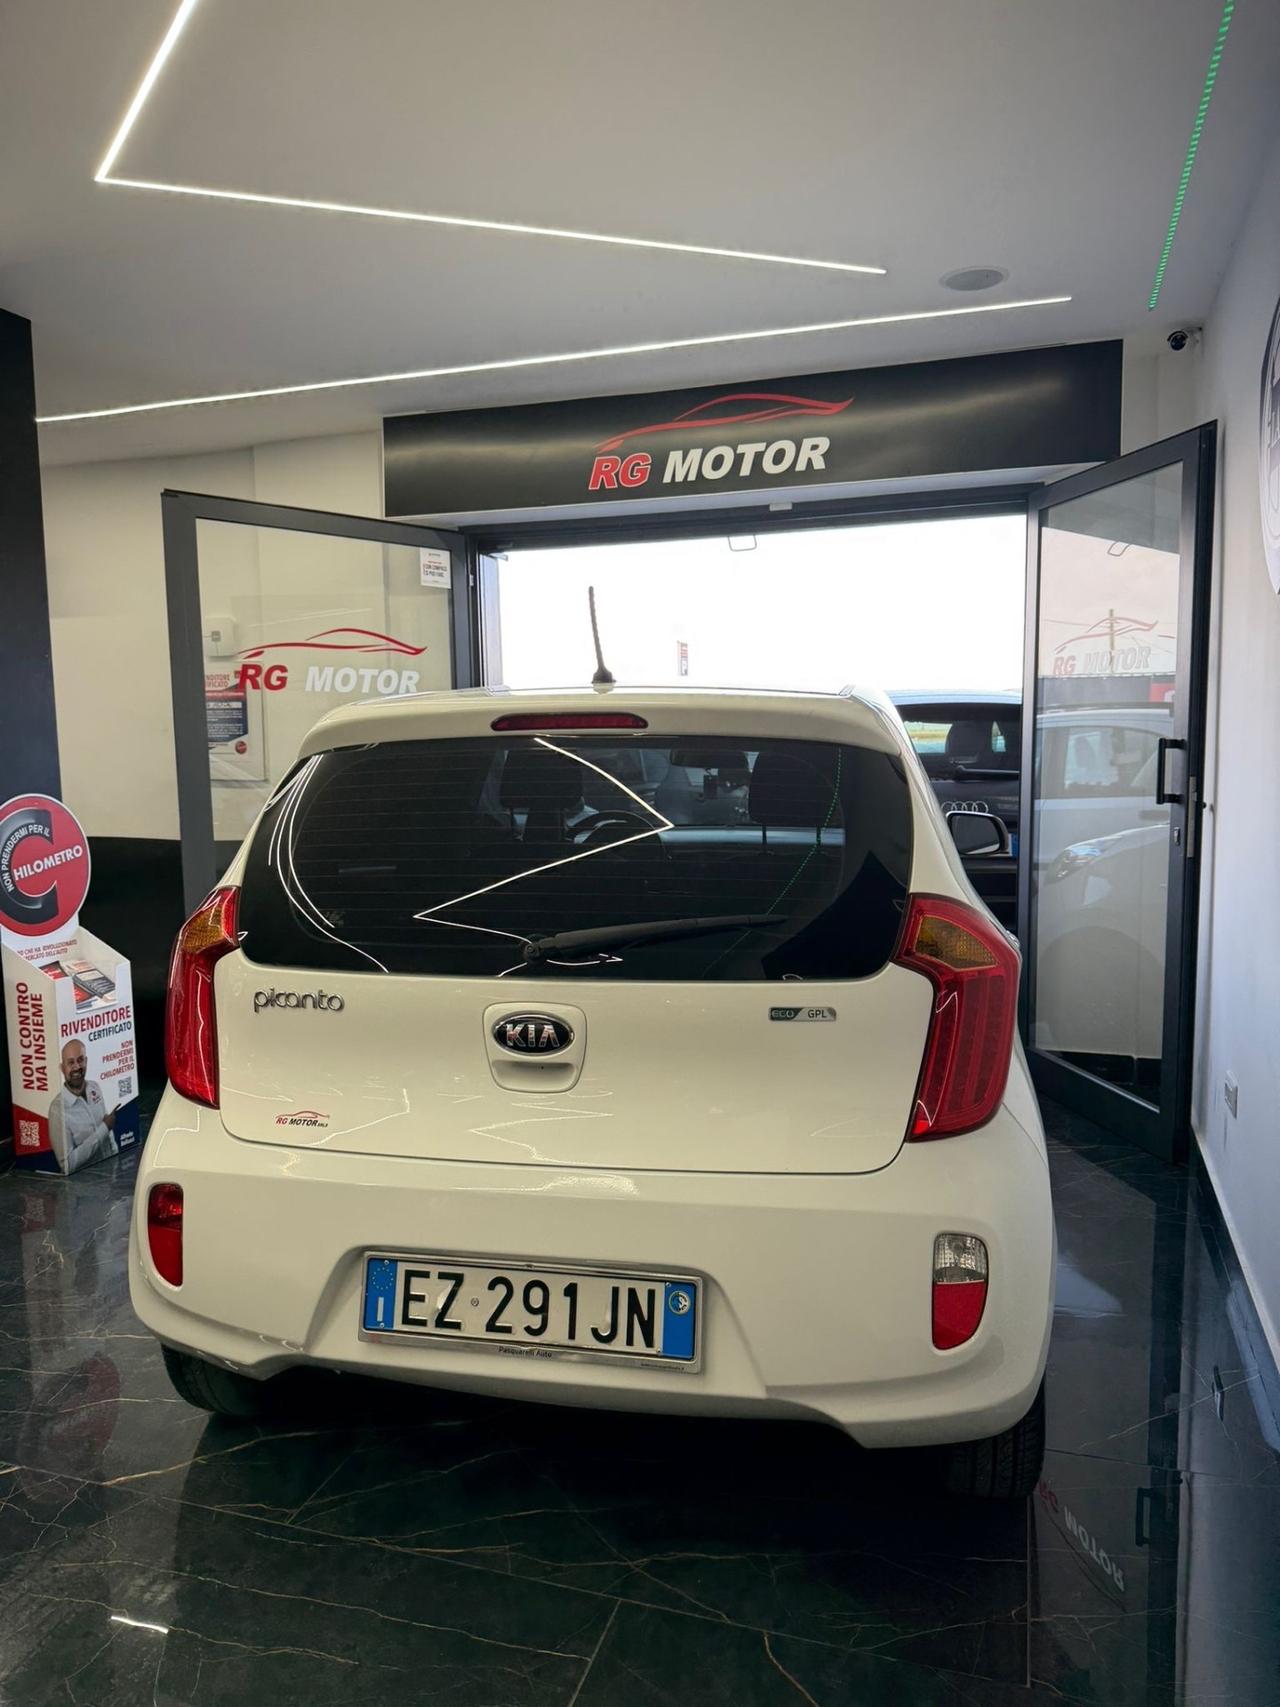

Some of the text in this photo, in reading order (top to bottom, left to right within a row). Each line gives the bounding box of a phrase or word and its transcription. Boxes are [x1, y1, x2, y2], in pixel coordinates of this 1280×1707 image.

[588, 436, 831, 490] RG MOTOR
[1053, 646, 1151, 676] RG MOTOR
[238, 664, 420, 693] RG MOTOR
[28, 824, 44, 834] PER
[1, 826, 29, 871] PRENDERMI
[2, 872, 15, 892] NON
[254, 987, 344, 1014] picanto
[61, 1006, 131, 1037] RIVENDITORE
[807, 1009, 828, 1019] GPL
[16, 982, 35, 1090] NON CONTRO
[30, 993, 48, 1092] MA INSIEME
[88, 1021, 132, 1042] CERTIFICATO
[121, 1040, 133, 1049] NON
[506, 1023, 560, 1048] KIA
[102, 1048, 134, 1063] PRENDERMI
[100, 1063, 135, 1081] CHILOMETRO
[276, 1117, 288, 1125] RG
[289, 1118, 318, 1127] MOTOR
[401, 1269, 465, 1331] EZ
